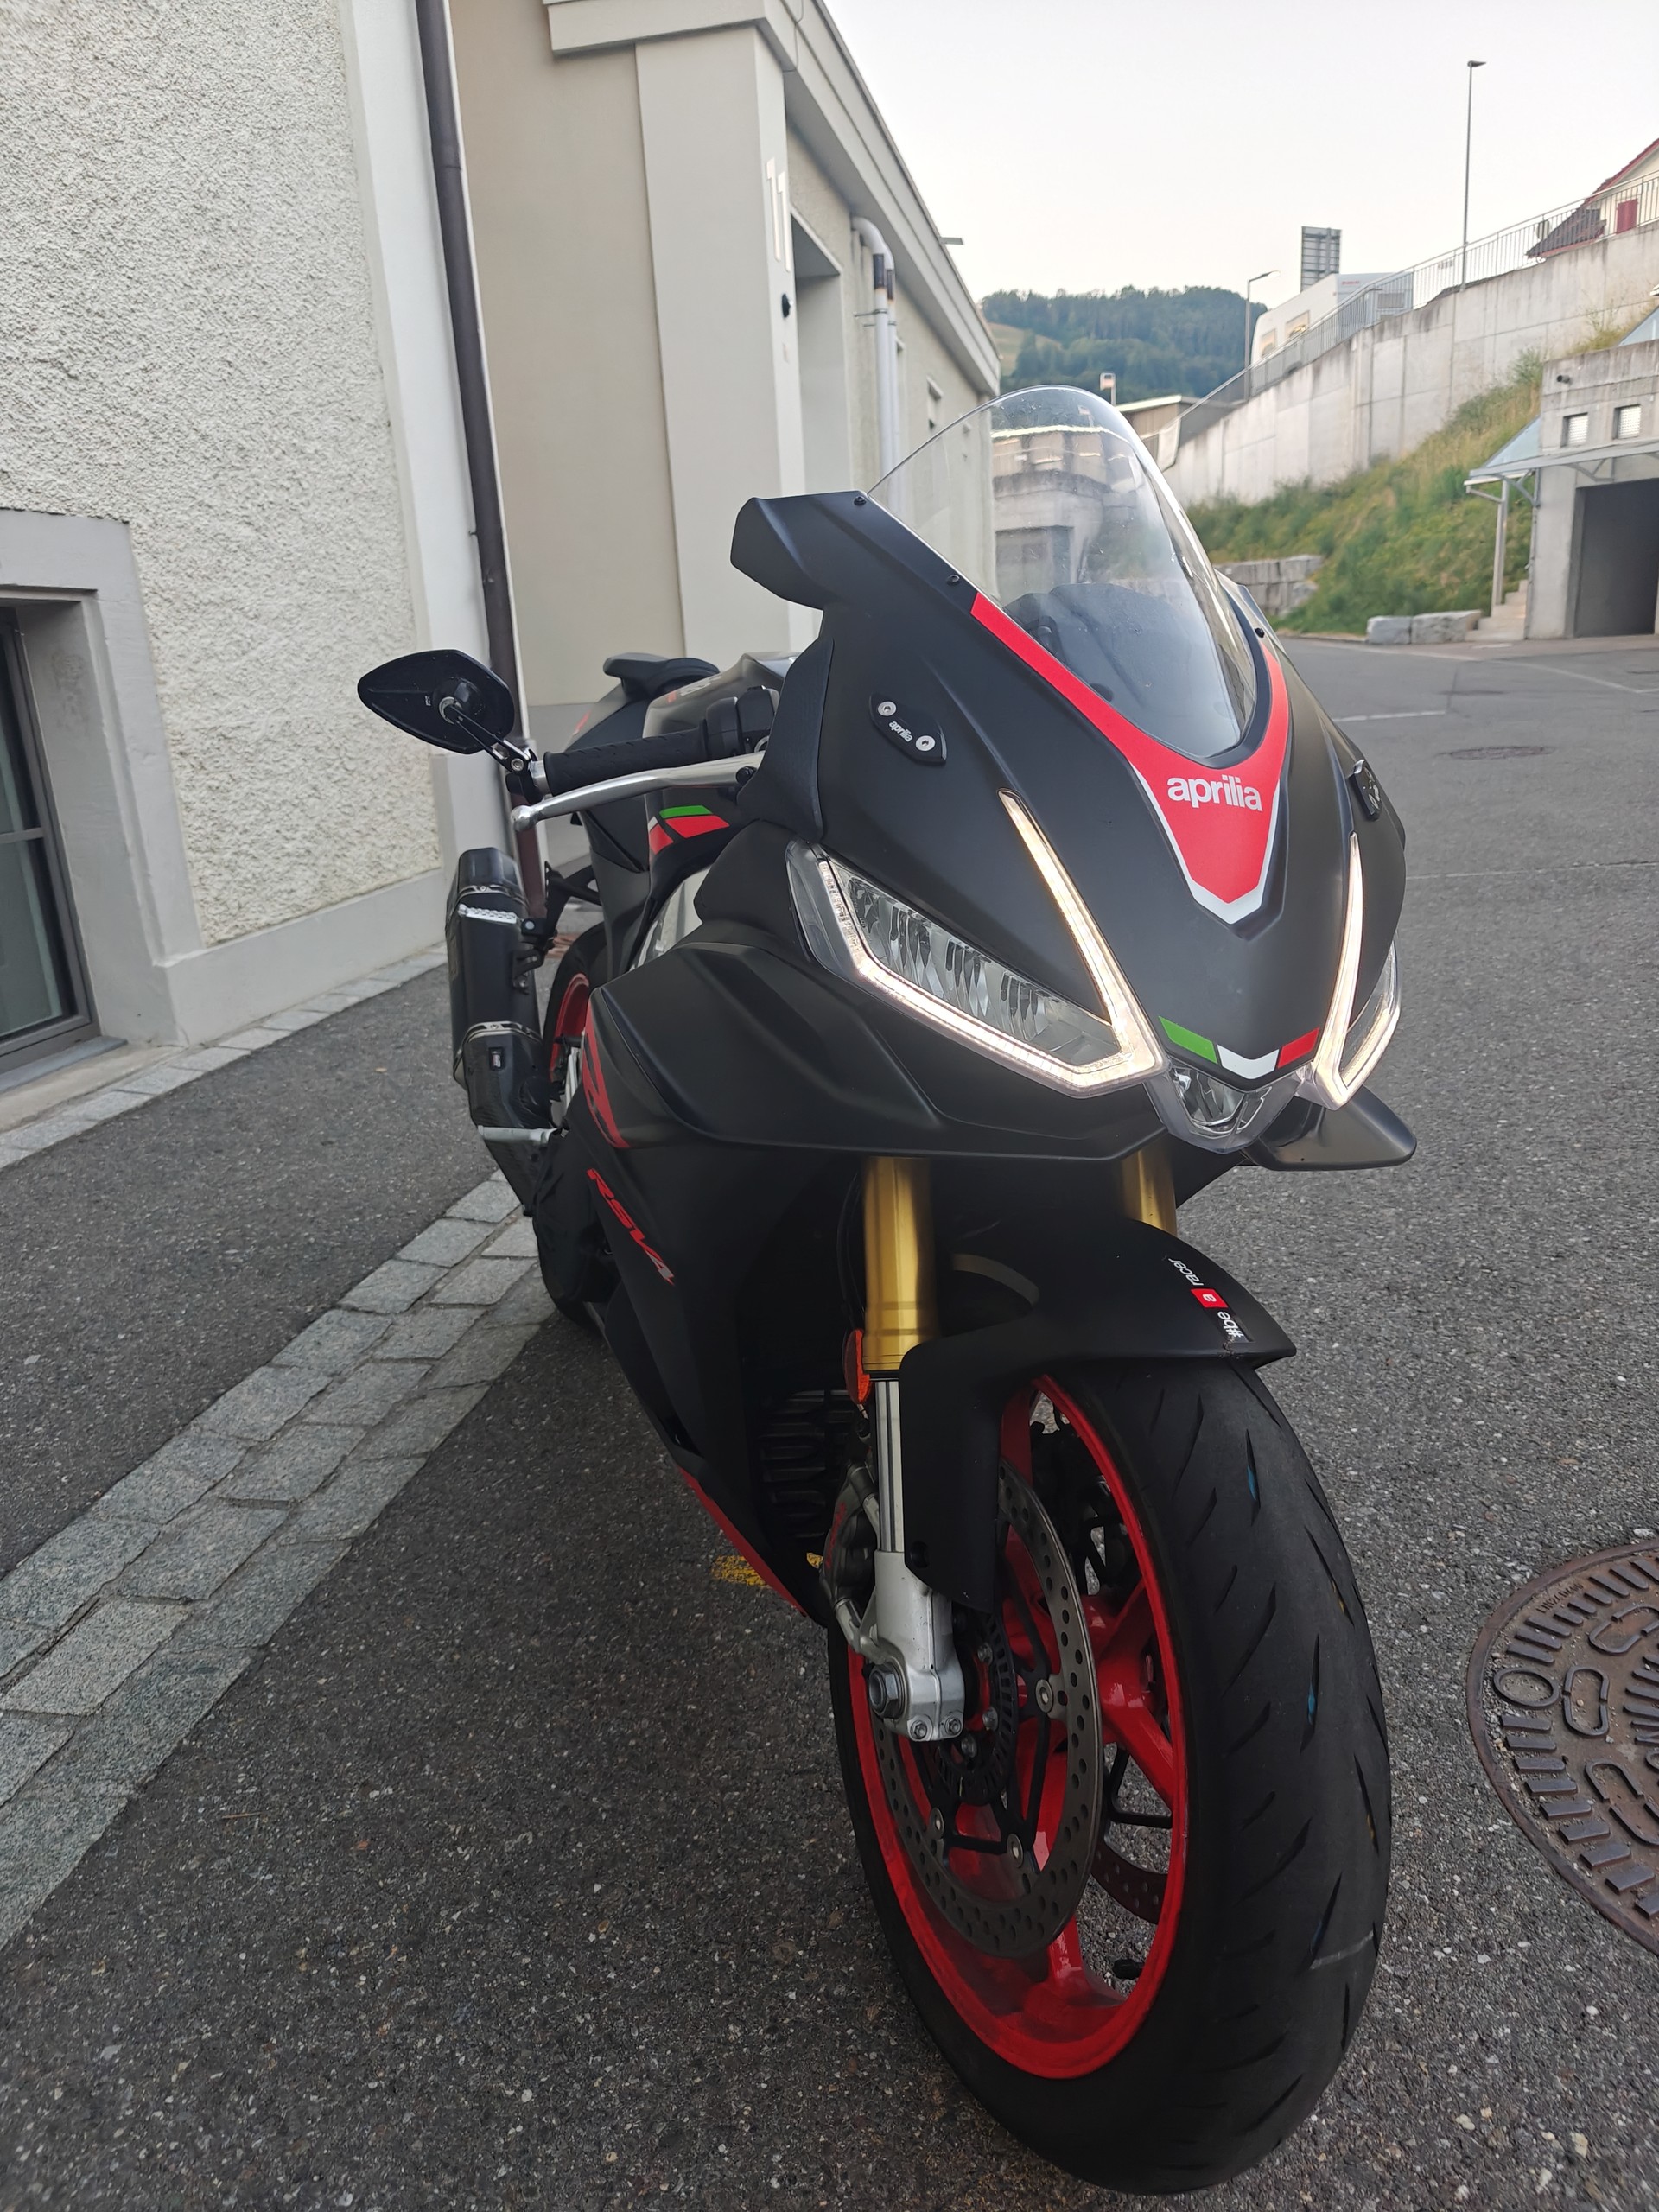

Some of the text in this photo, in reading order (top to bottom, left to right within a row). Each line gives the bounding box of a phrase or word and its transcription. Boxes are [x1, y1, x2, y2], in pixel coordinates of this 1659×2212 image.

[888, 721, 913, 742] aprilia
[1166, 773, 1263, 811] aprilia
[1168, 1258, 1205, 1287] racer
[1217, 1311, 1244, 1338] #be
